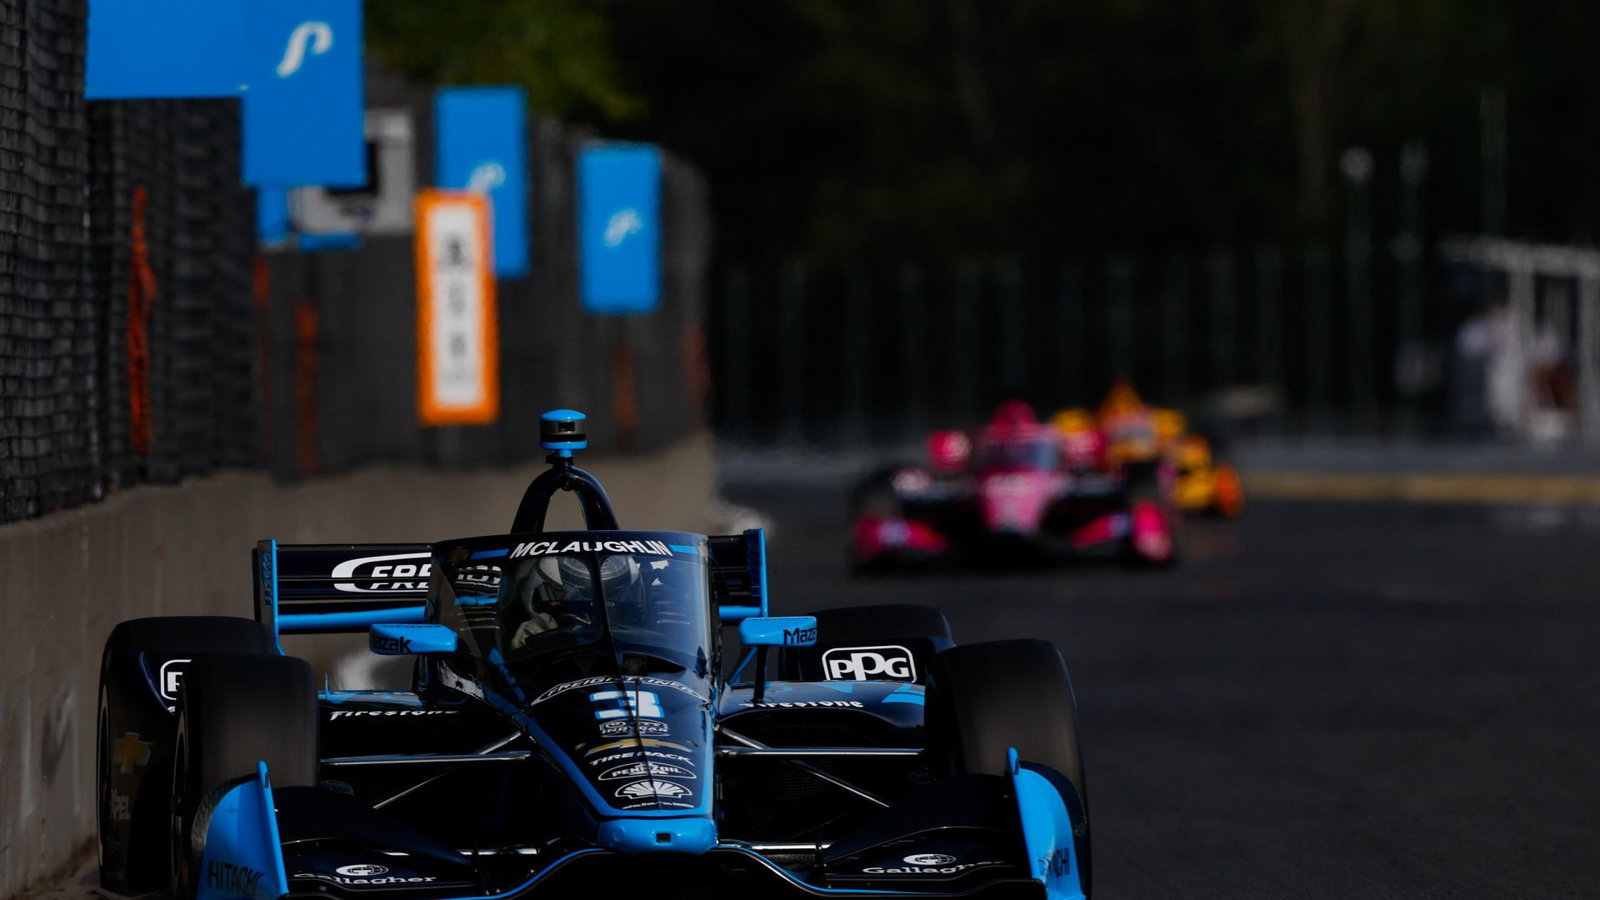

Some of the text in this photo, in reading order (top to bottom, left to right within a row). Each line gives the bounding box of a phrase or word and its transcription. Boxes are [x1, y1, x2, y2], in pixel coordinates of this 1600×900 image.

[509, 541, 673, 559] MCLAUGHLIN
[829, 652, 911, 681] PPG
[588, 690, 666, 720] 3
